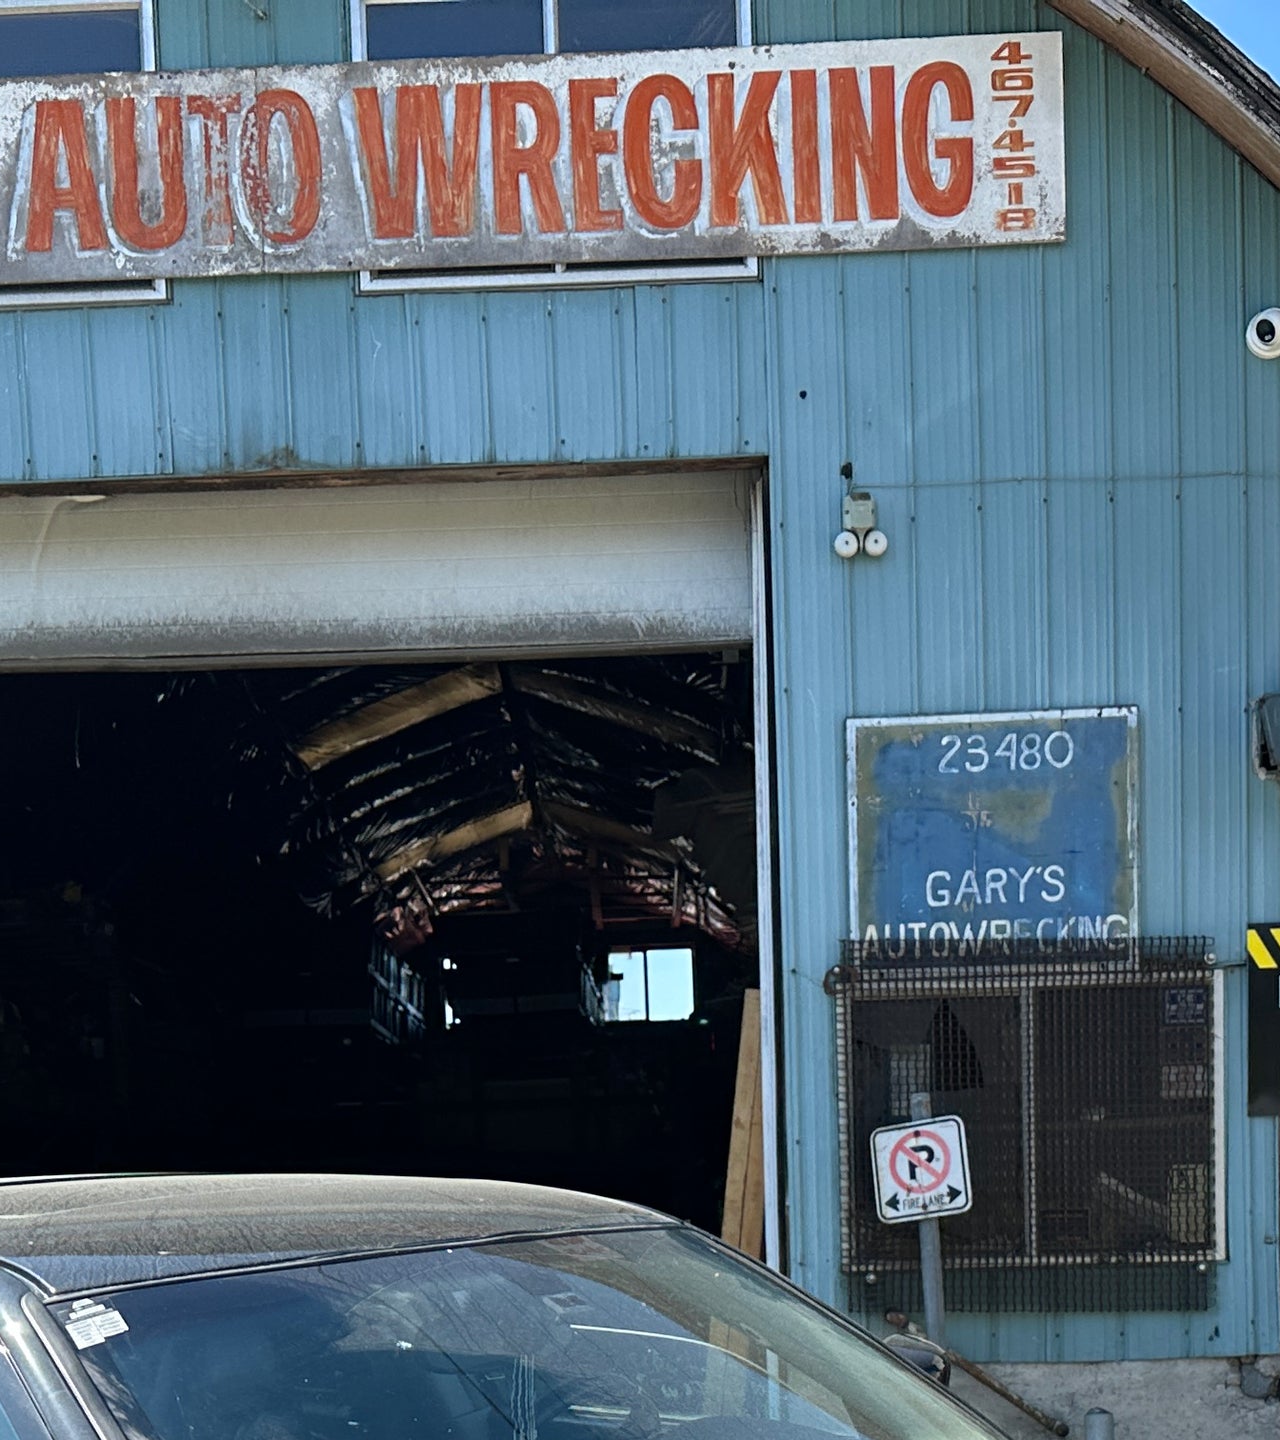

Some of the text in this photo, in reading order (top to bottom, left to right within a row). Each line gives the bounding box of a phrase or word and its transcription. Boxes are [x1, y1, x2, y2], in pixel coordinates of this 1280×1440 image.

[25, 87, 321, 252] AUTO
[352, 60, 975, 240] WRECKING
[937, 730, 1075, 774] 23480
[925, 864, 1066, 908] GARY'S
[902, 1198, 921, 1211] FIRE
